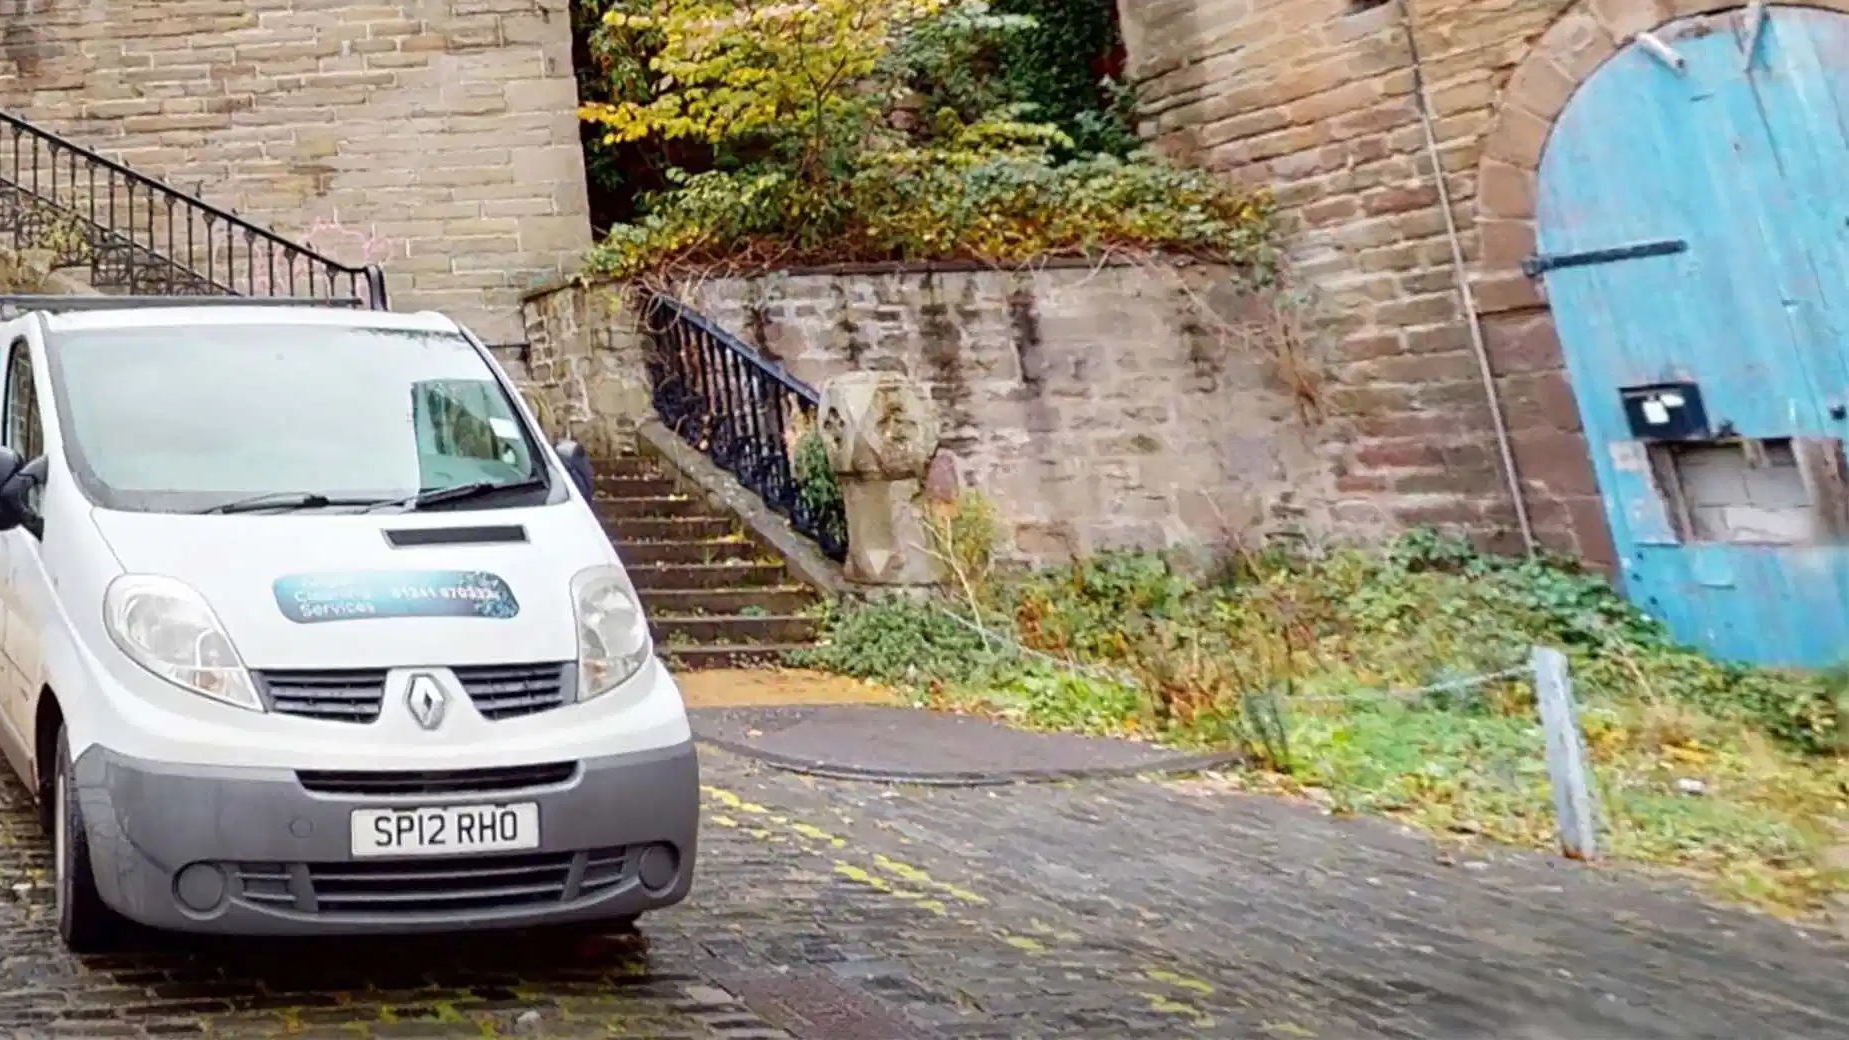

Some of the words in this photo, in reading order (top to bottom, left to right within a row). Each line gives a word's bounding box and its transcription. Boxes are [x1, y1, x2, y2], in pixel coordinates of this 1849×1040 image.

[299, 601, 376, 618] Services
[374, 814, 446, 847] SP12
[457, 810, 517, 844] RHO
